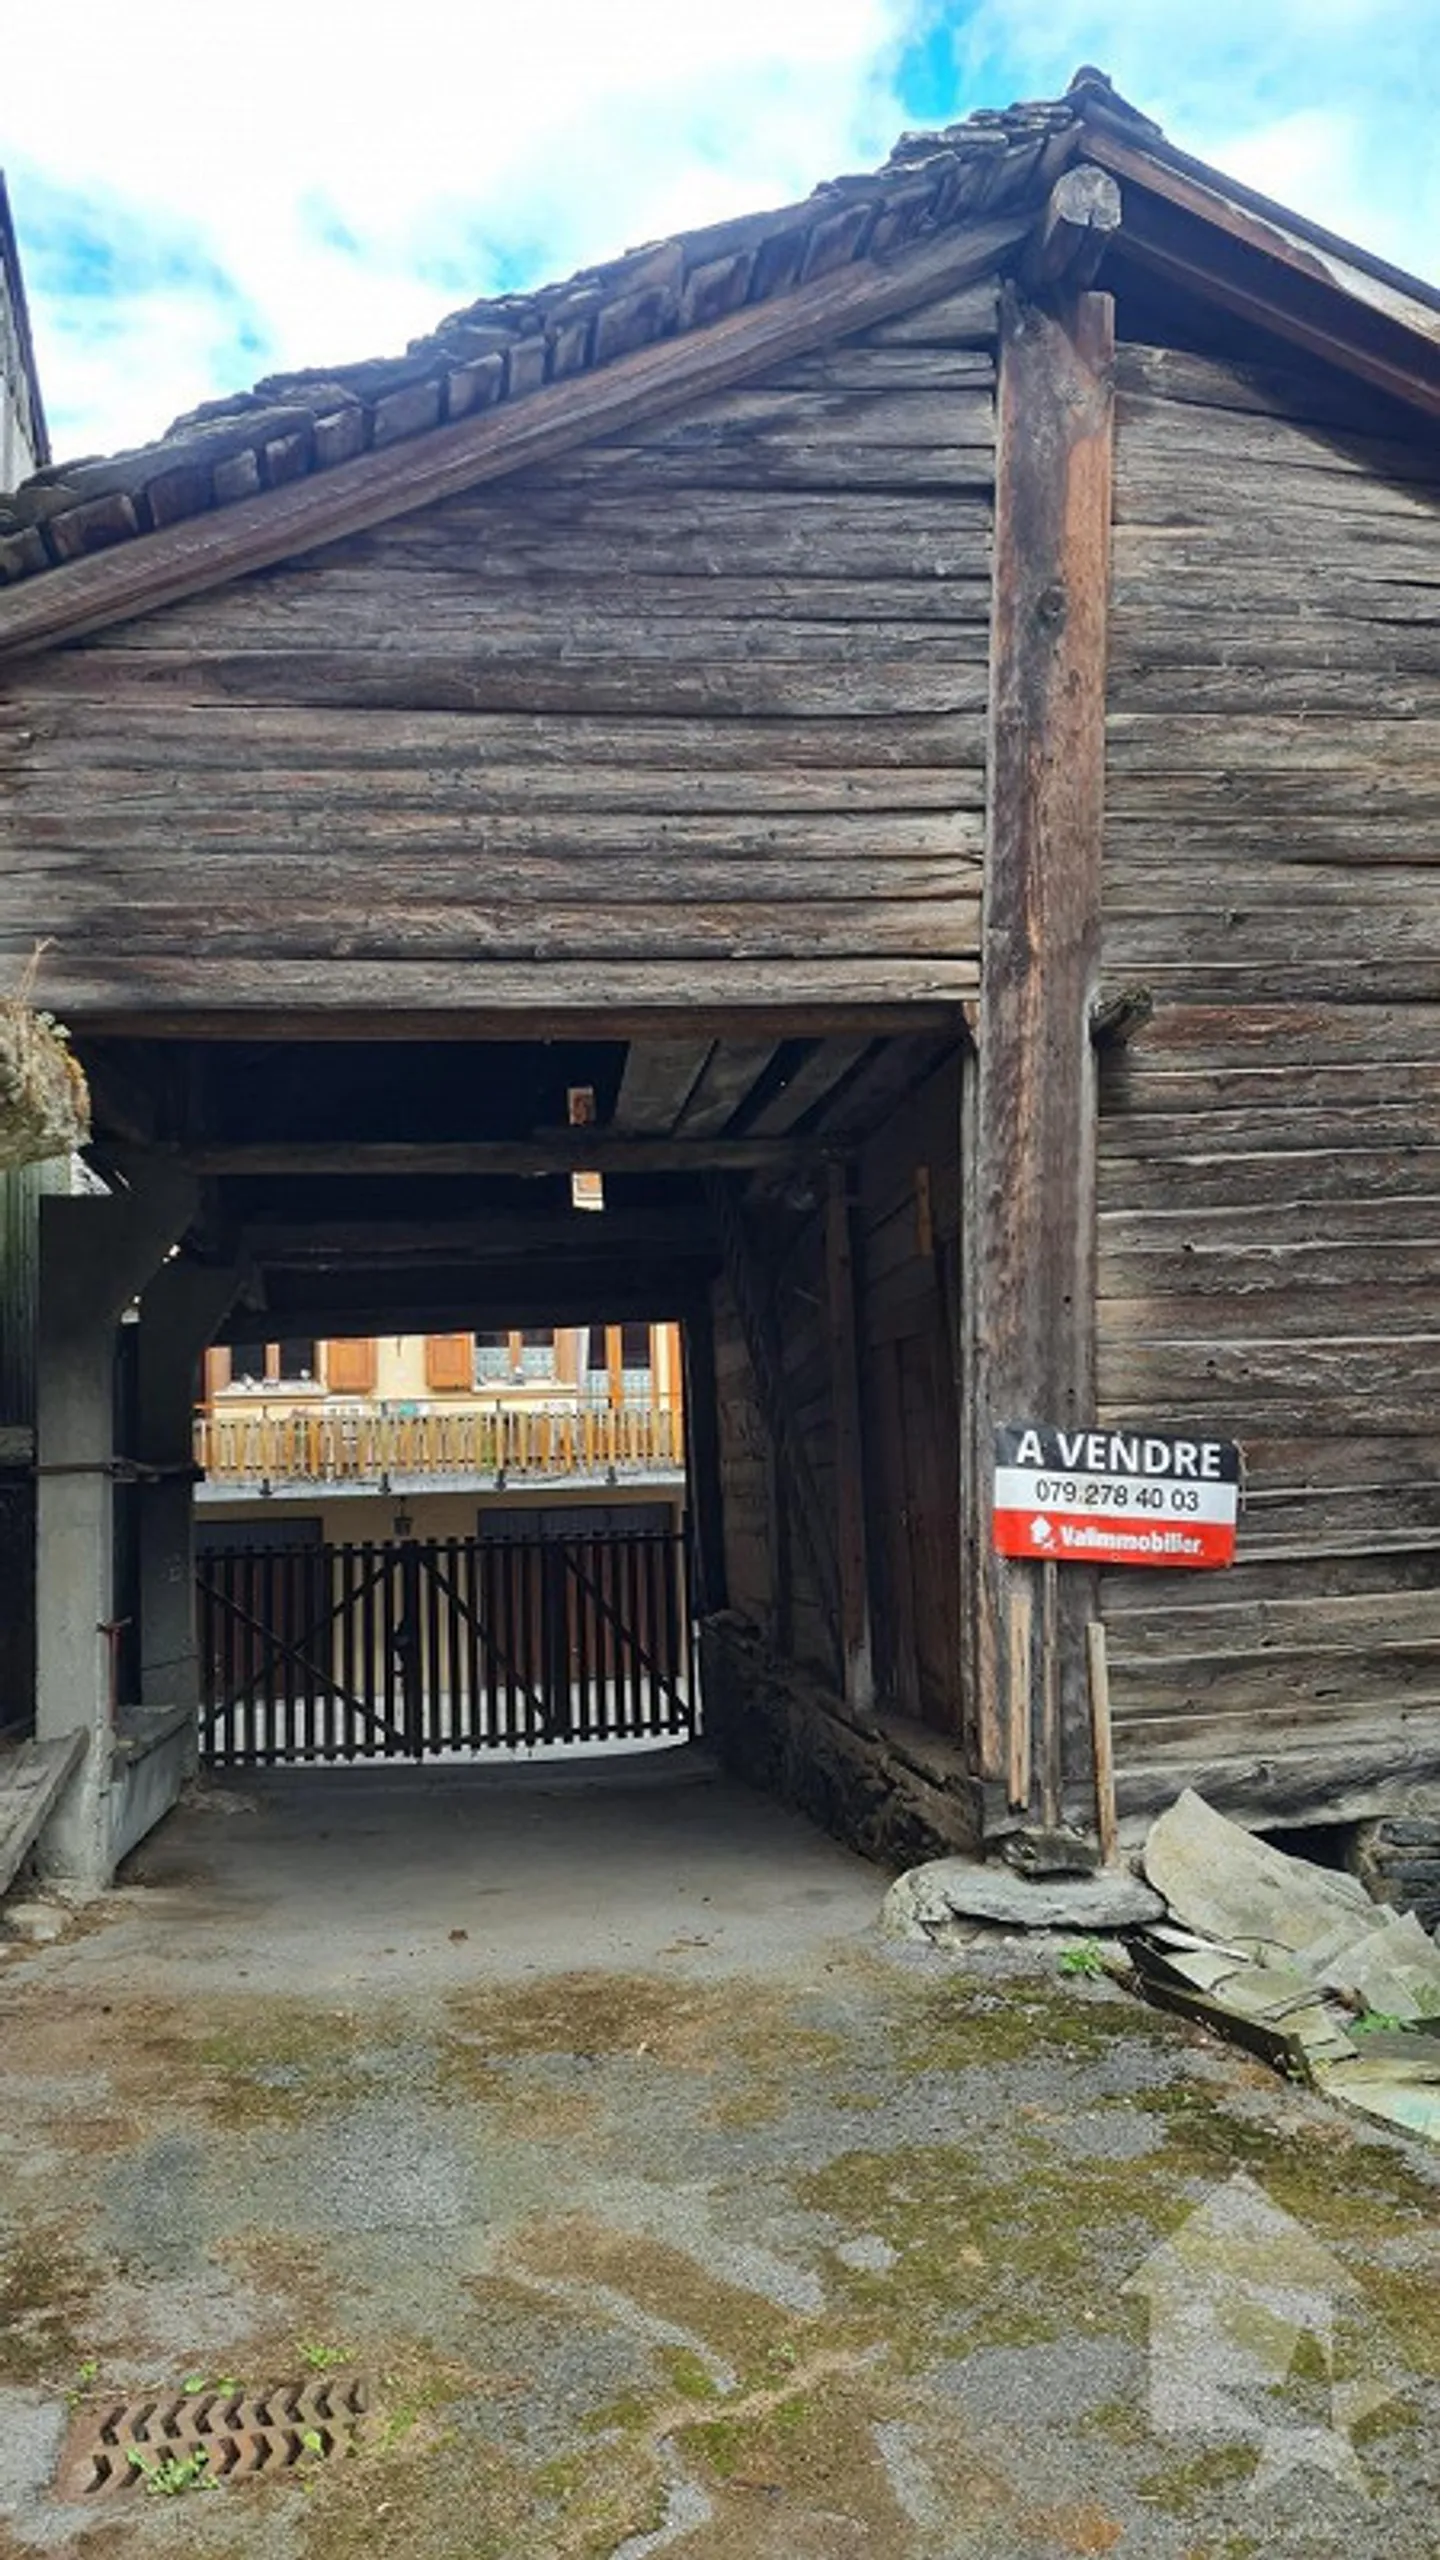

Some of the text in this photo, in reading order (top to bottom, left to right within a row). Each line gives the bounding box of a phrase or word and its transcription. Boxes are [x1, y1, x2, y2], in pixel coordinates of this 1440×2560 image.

[1016, 1430, 1221, 1478] A VENDRE
[1085, 1484, 1128, 1506] 278
[1136, 1488, 1164, 1508] 40
[1171, 1489, 1199, 1512] 03
